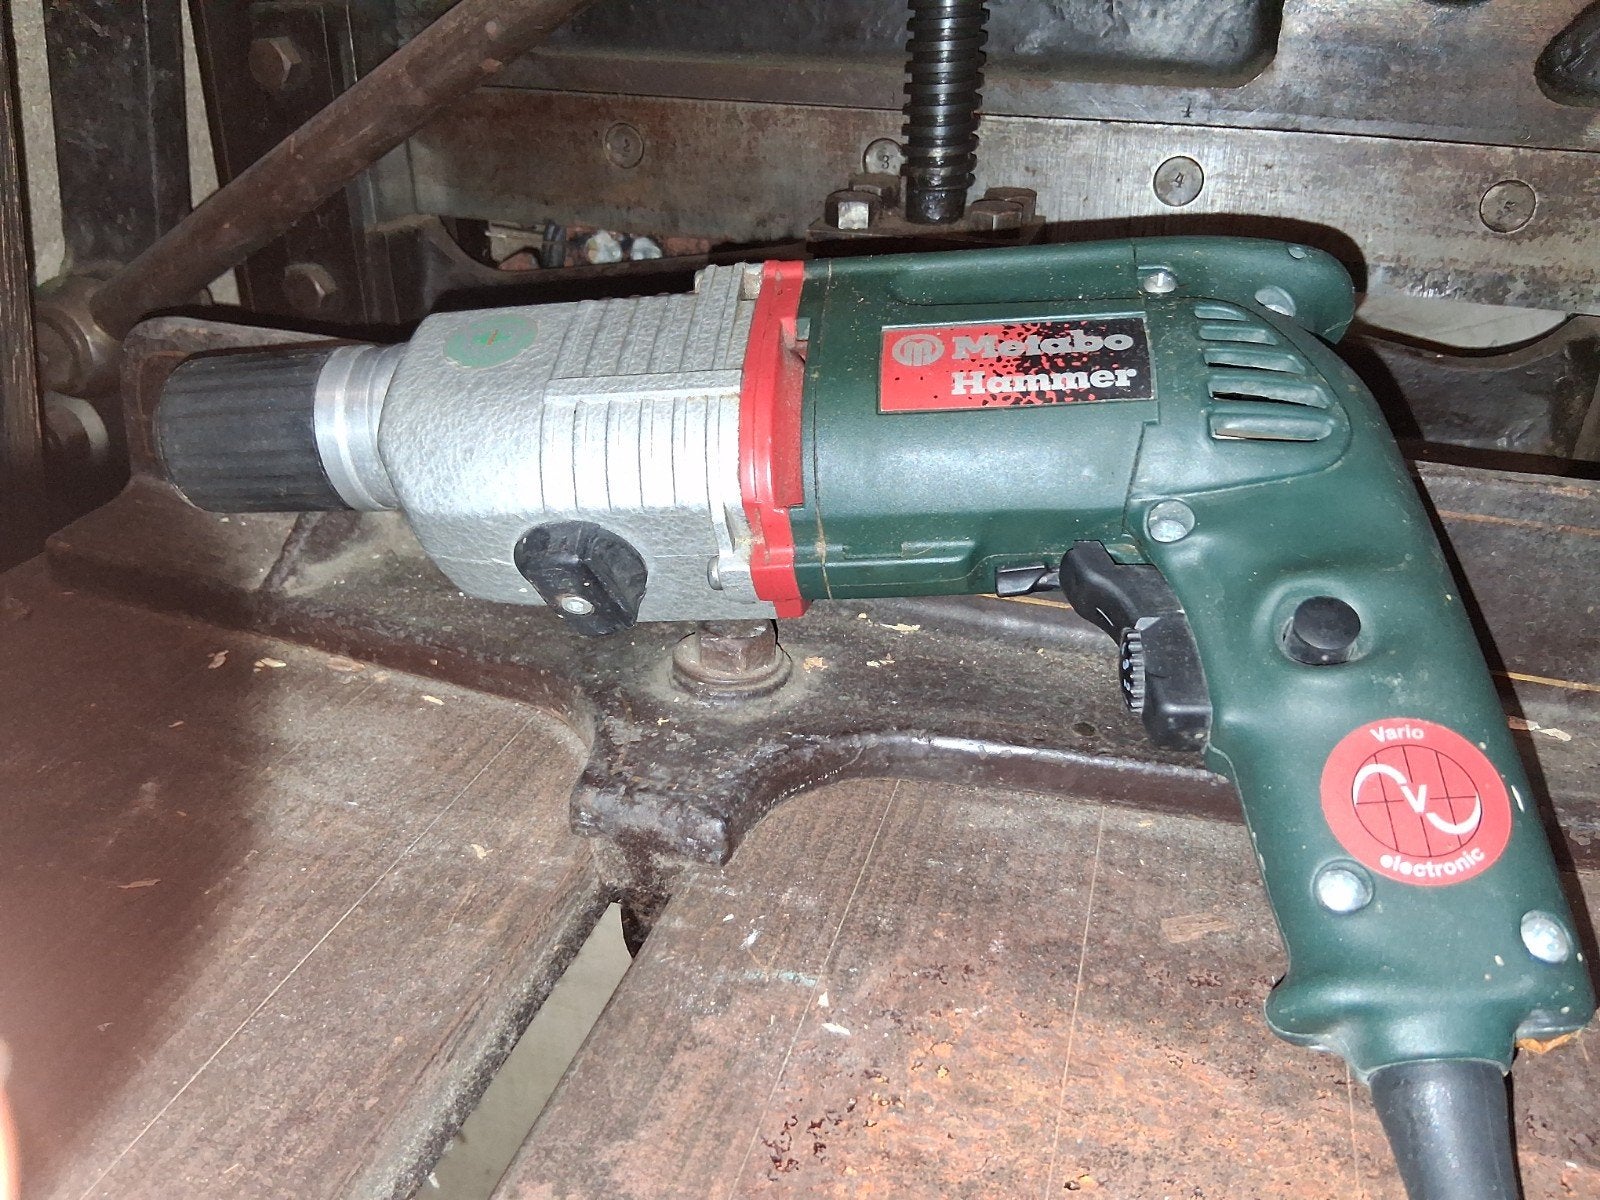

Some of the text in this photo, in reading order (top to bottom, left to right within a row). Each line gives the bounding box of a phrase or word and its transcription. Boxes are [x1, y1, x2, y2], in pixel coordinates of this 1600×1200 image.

[951, 330, 1134, 360] Metabo
[951, 368, 1138, 395] Hammer
[1369, 724, 1425, 743] Vario
[1379, 847, 1486, 879] electronic
